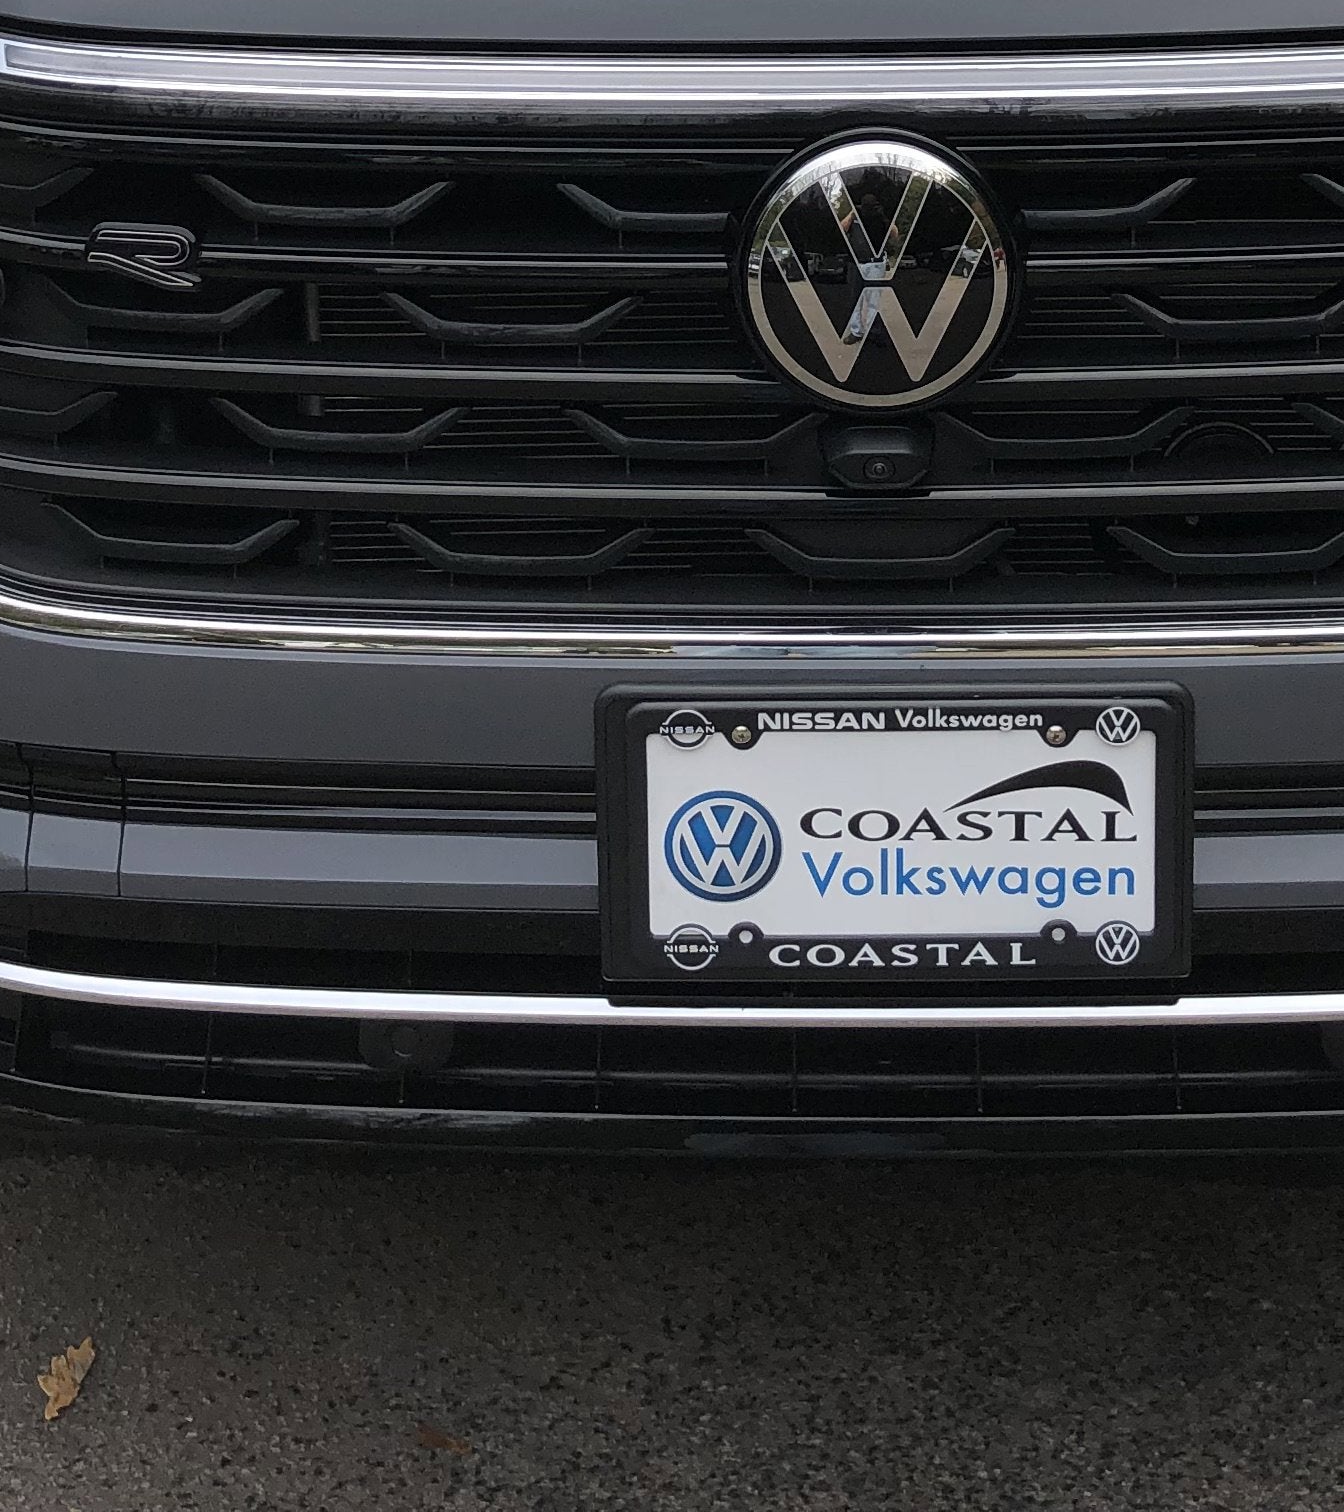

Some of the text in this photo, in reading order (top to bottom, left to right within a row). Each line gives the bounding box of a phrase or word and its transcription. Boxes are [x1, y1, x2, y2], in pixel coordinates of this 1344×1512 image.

[659, 725, 715, 734] NISSAN
[757, 709, 1043, 731] NISSAN Volkswagen
[799, 808, 1138, 842] COASTAL
[801, 848, 1135, 908] Volkswagen
[663, 944, 719, 953] NISSAN
[769, 943, 1036, 967] COASTAL
